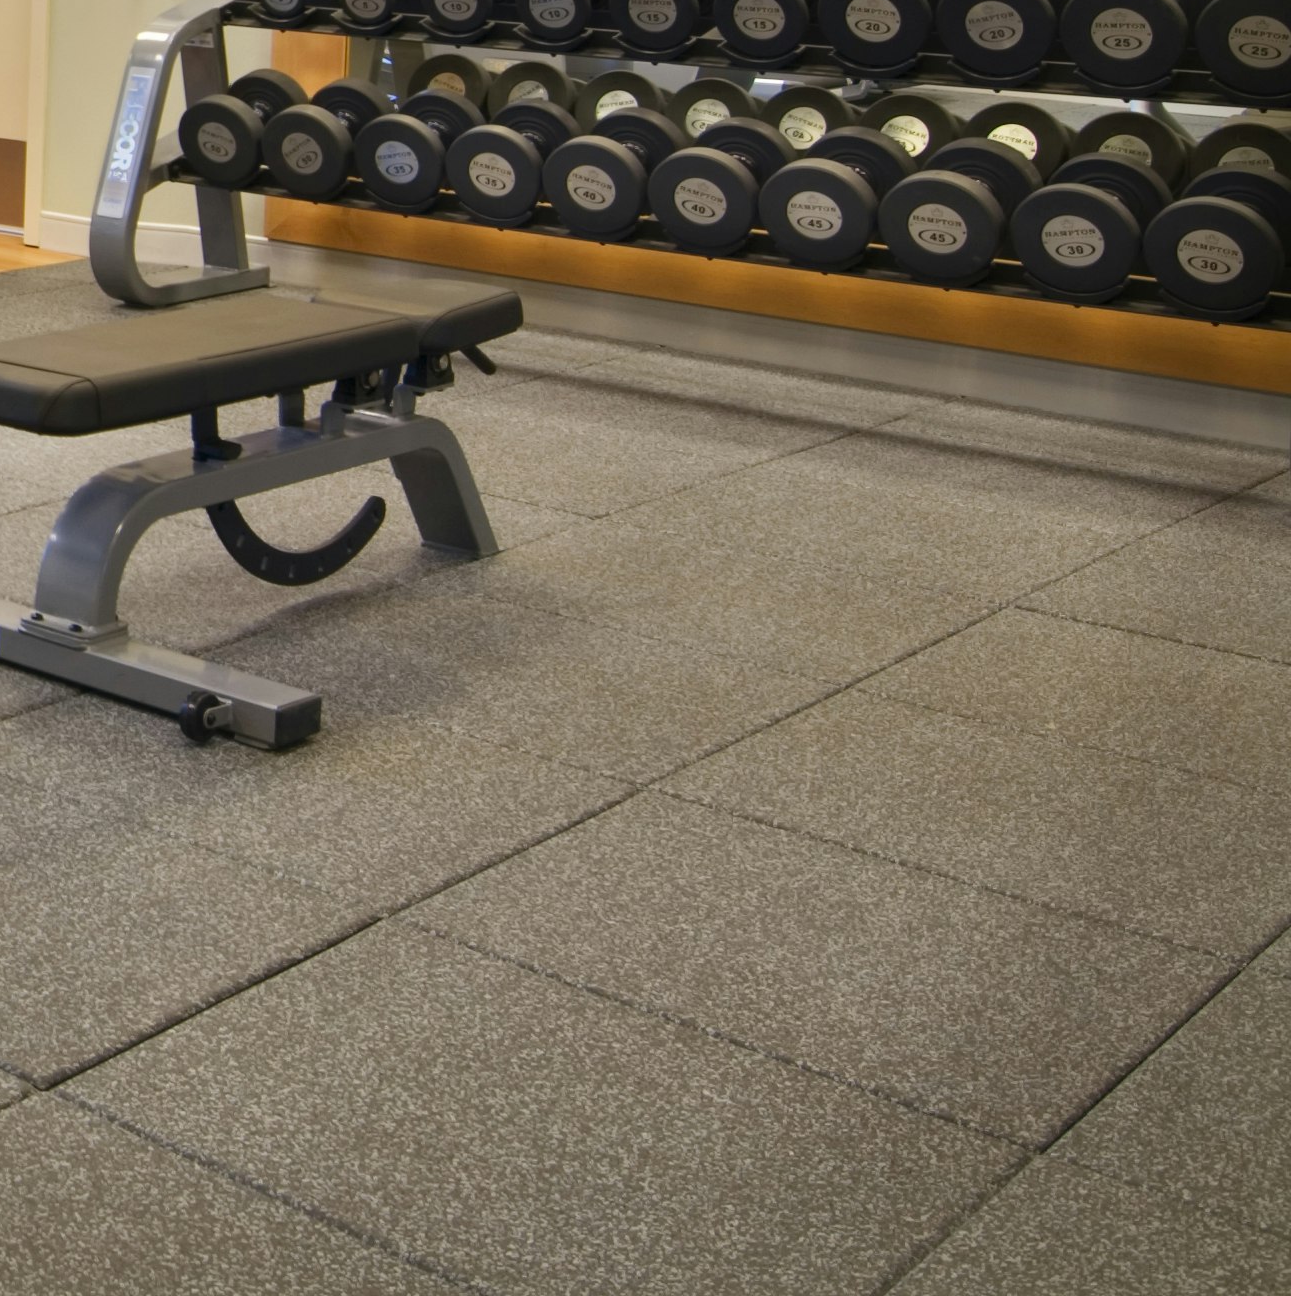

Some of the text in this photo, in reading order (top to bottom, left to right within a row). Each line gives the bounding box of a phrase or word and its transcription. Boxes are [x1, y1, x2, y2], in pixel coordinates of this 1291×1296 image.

[646, 14, 660, 22] 15
[753, 21, 766, 29] 15
[865, 22, 880, 32] 20
[989, 29, 1005, 39] 20
[1234, 27, 1290, 41] HAMPTON
[1114, 38, 1131, 48] 25
[1251, 46, 1268, 56] 25
[582, 190, 596, 201] 40
[691, 204, 706, 215] 40
[807, 219, 823, 229] 45
[912, 214, 962, 228] HAMPTON
[929, 233, 946, 243] 45
[1044, 228, 1096, 238] HAMPTON
[1067, 245, 1084, 255] 30
[1183, 240, 1239, 257] HAMPTON
[1200, 259, 1218, 271] 30
